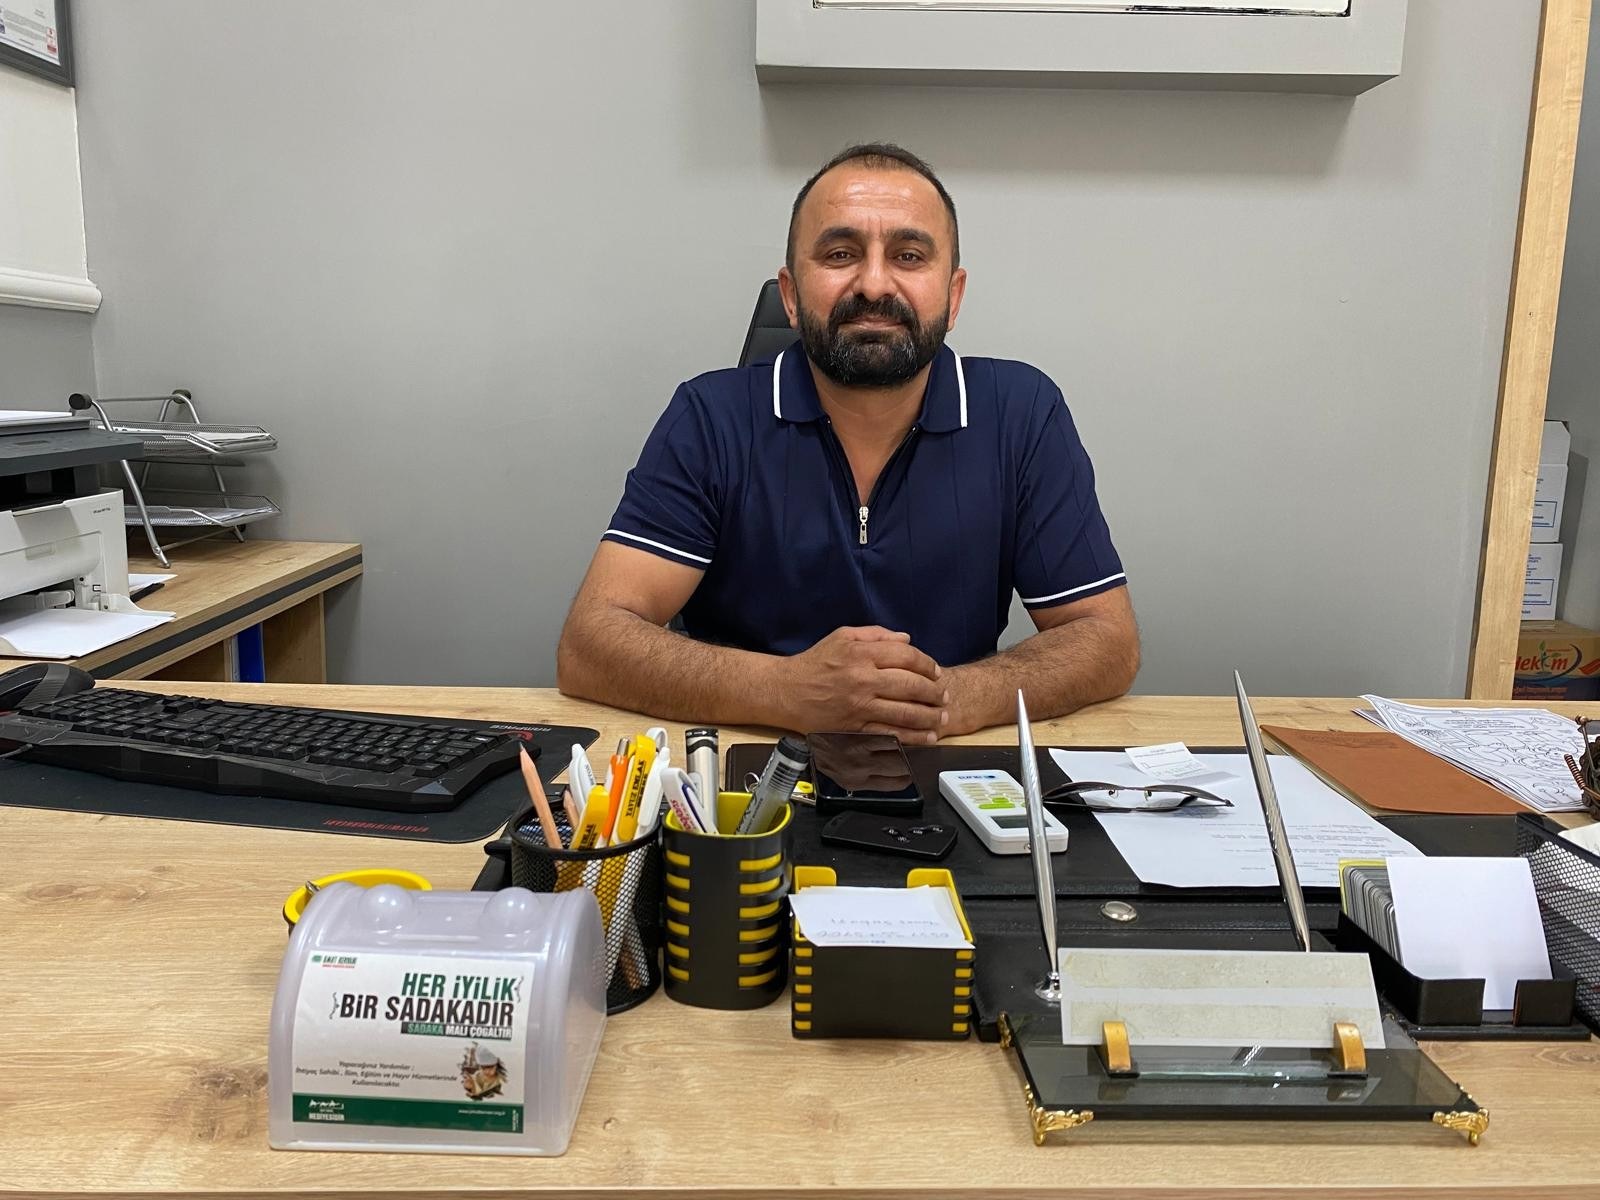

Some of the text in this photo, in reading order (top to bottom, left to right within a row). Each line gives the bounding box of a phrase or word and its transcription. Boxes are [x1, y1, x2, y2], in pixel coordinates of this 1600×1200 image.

[401, 972, 446, 997] HER
[385, 996, 514, 1026] SADAKADIR
[407, 1023, 444, 1035] SADAKA
[445, 1025, 468, 1037] MALI
